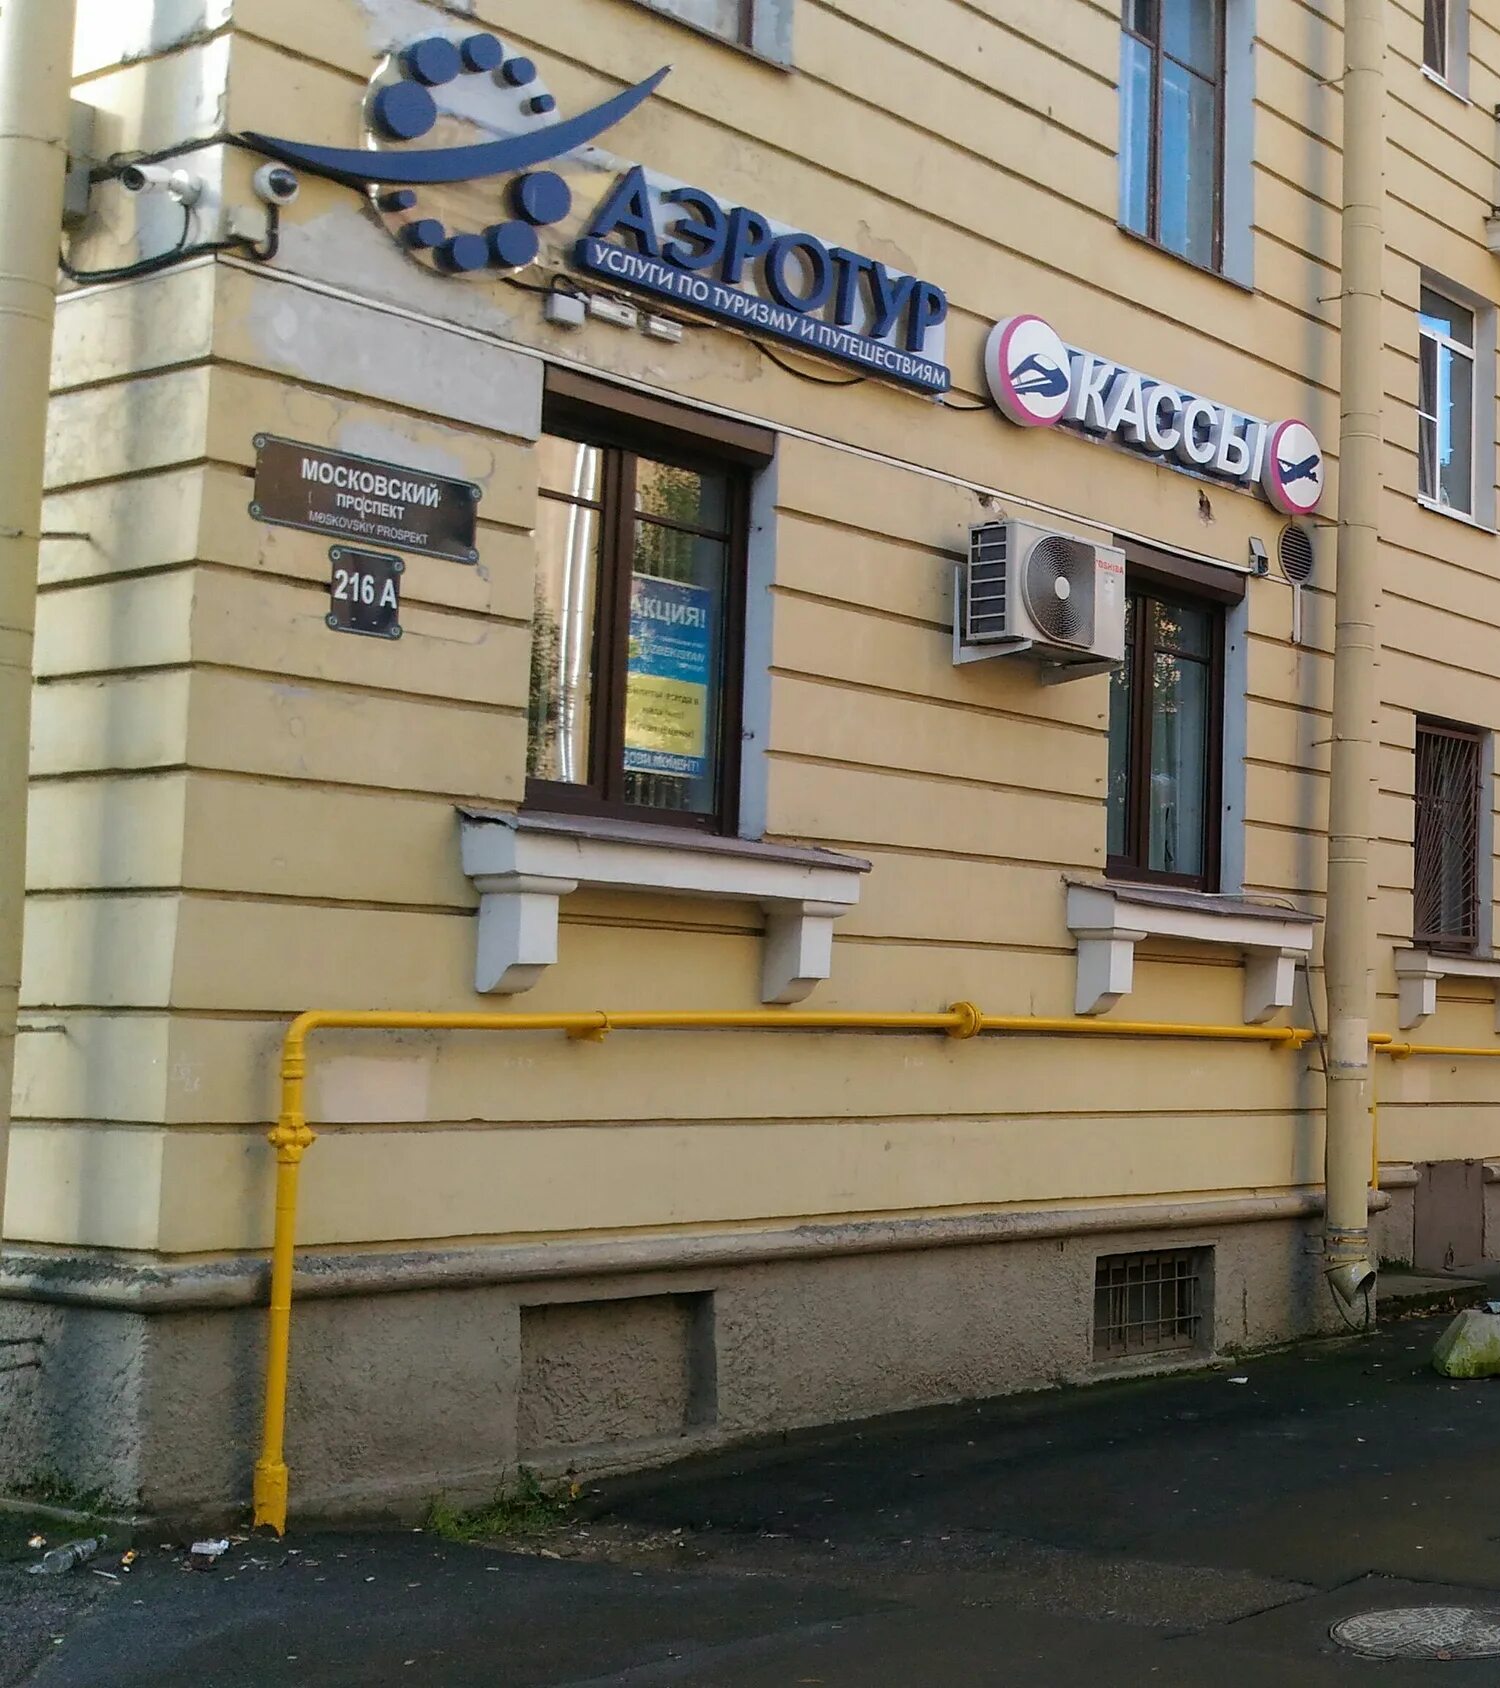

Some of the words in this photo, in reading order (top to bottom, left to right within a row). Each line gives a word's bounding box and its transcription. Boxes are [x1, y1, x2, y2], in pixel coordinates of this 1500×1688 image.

[587, 165, 948, 353] АЭРОТУР
[594, 244, 675, 291] УСЛУГИ
[677, 275, 709, 302] ПО
[713, 286, 798, 333] ТУРИЗМУ
[801, 319, 815, 341] И
[818, 325, 947, 389] ПУТЕШЕСТВИЯМ
[1073, 354, 1268, 483] КАССЫ
[301, 458, 441, 509] МОСКОВСКИЙ
[308, 510, 376, 535] MOSKOVSKIY
[376, 525, 429, 546] PROSPEKT
[336, 493, 405, 521] ПРОСПЕКТ
[334, 569, 375, 605] 216
[631, 594, 706, 630] АКЦИЯ!
